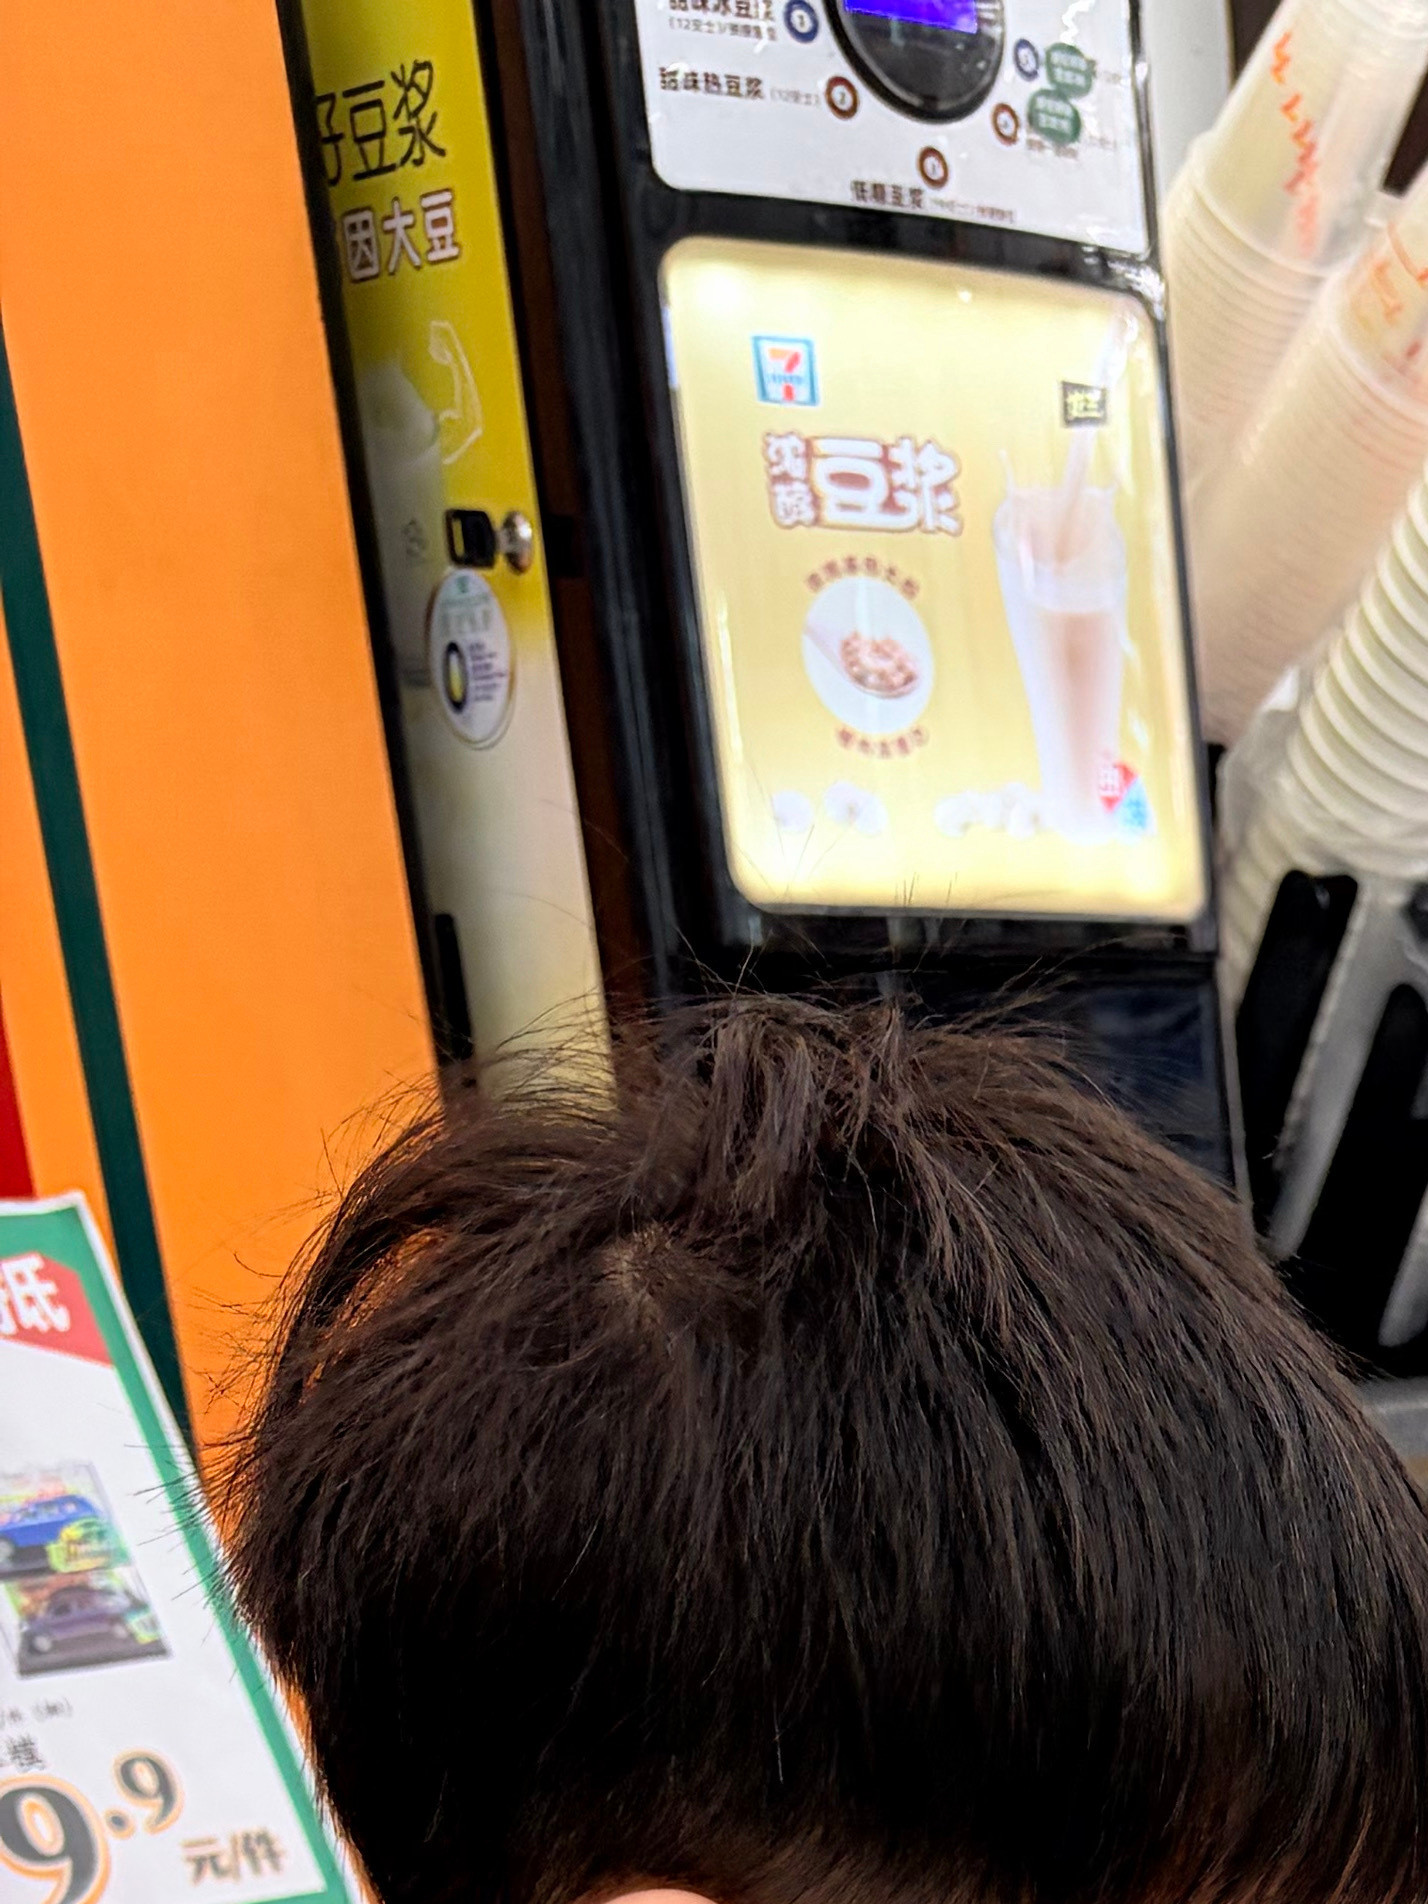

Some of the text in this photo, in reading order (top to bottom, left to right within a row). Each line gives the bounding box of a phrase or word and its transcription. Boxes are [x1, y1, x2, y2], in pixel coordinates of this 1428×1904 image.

[342, 188, 460, 283] 因大豆
[811, 436, 964, 538] 豆浆
[180, 1825, 287, 1887] 元/件
